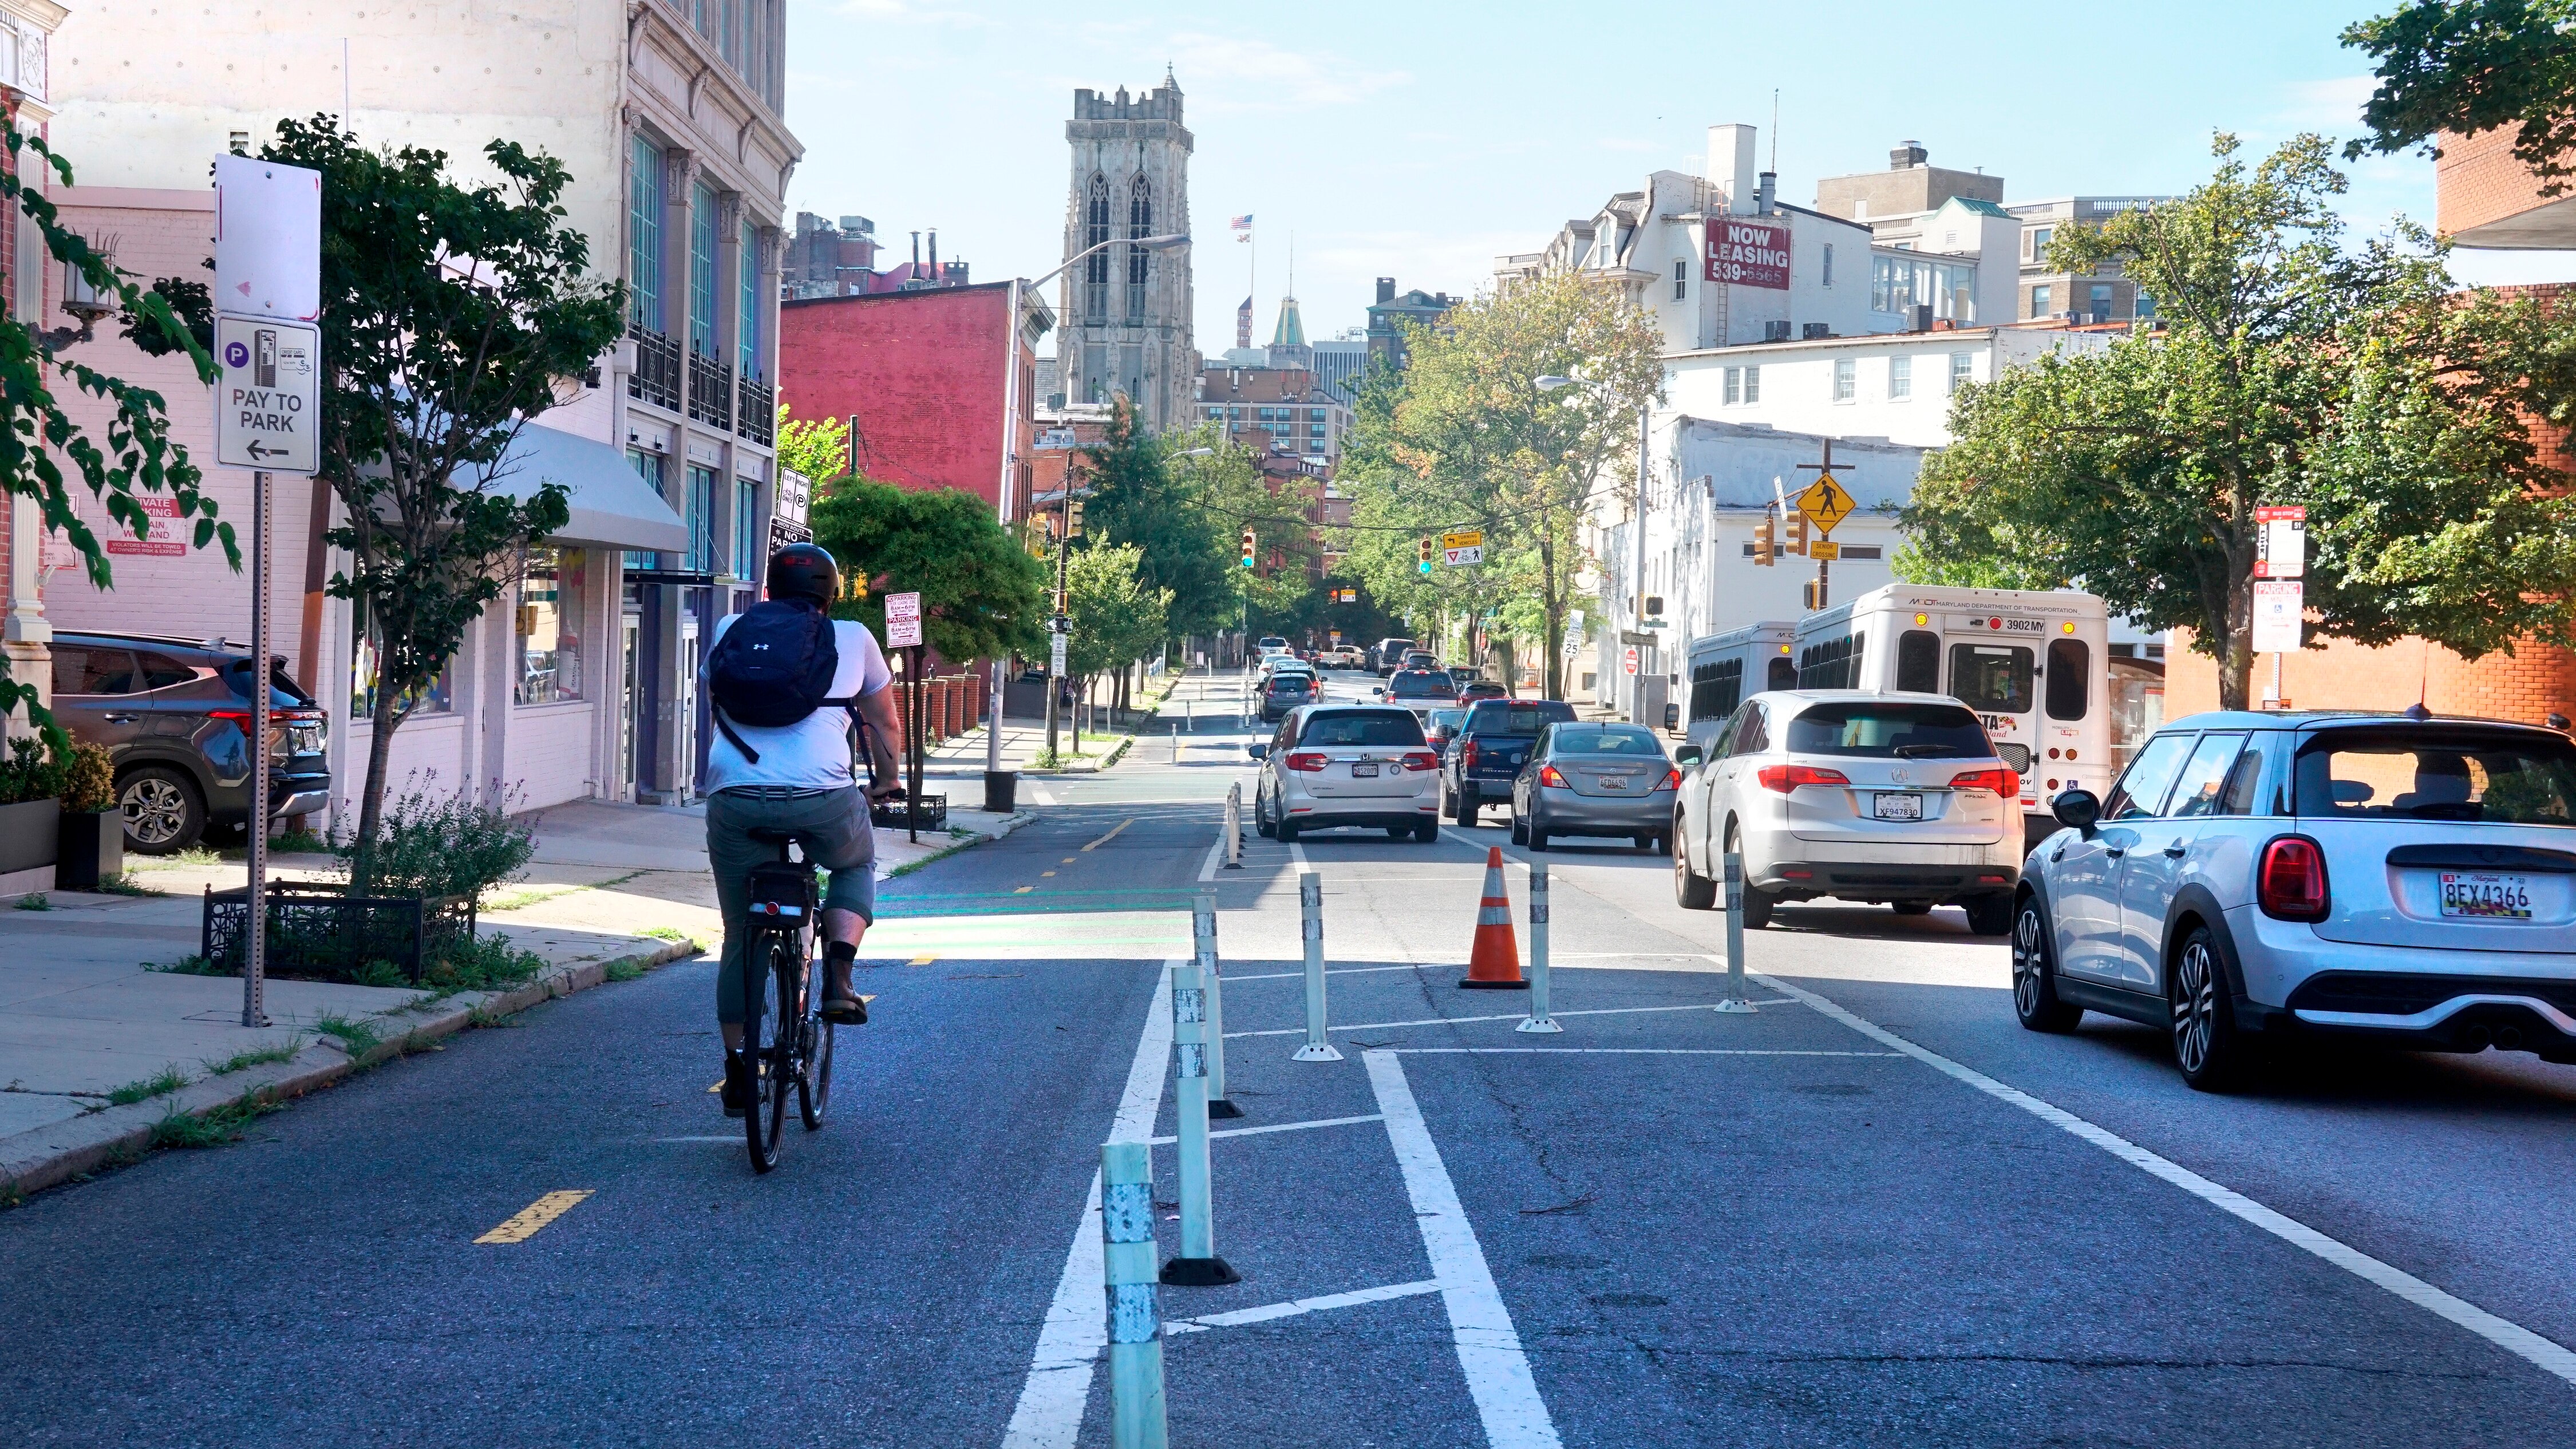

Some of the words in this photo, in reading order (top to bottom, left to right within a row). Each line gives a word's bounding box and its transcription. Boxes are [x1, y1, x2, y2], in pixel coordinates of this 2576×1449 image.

[1729, 225, 1771, 247] NOW
[1708, 241, 1788, 268] LEASING
[233, 389, 270, 409] PAY
[276, 394, 302, 412] TO
[241, 411, 294, 433] PARK
[784, 474, 795, 484] LEFT
[796, 478, 809, 488] RIGHT
[136, 498, 170, 507] IVATE
[782, 494, 793, 504] ONLY
[141, 508, 172, 517] KING
[777, 520, 789, 529] SNOW
[790, 525, 805, 535] ROUTE
[784, 530, 797, 542] NO
[2258, 584, 2298, 594] PARKING
[2023, 605, 2078, 614] TRANSPORTATION
[1565, 643, 1578, 654] 25
[1880, 808, 1918, 816] XF947830
[2471, 875, 2499, 884] Maryland
[2446, 884, 2528, 907] 8EX4366
